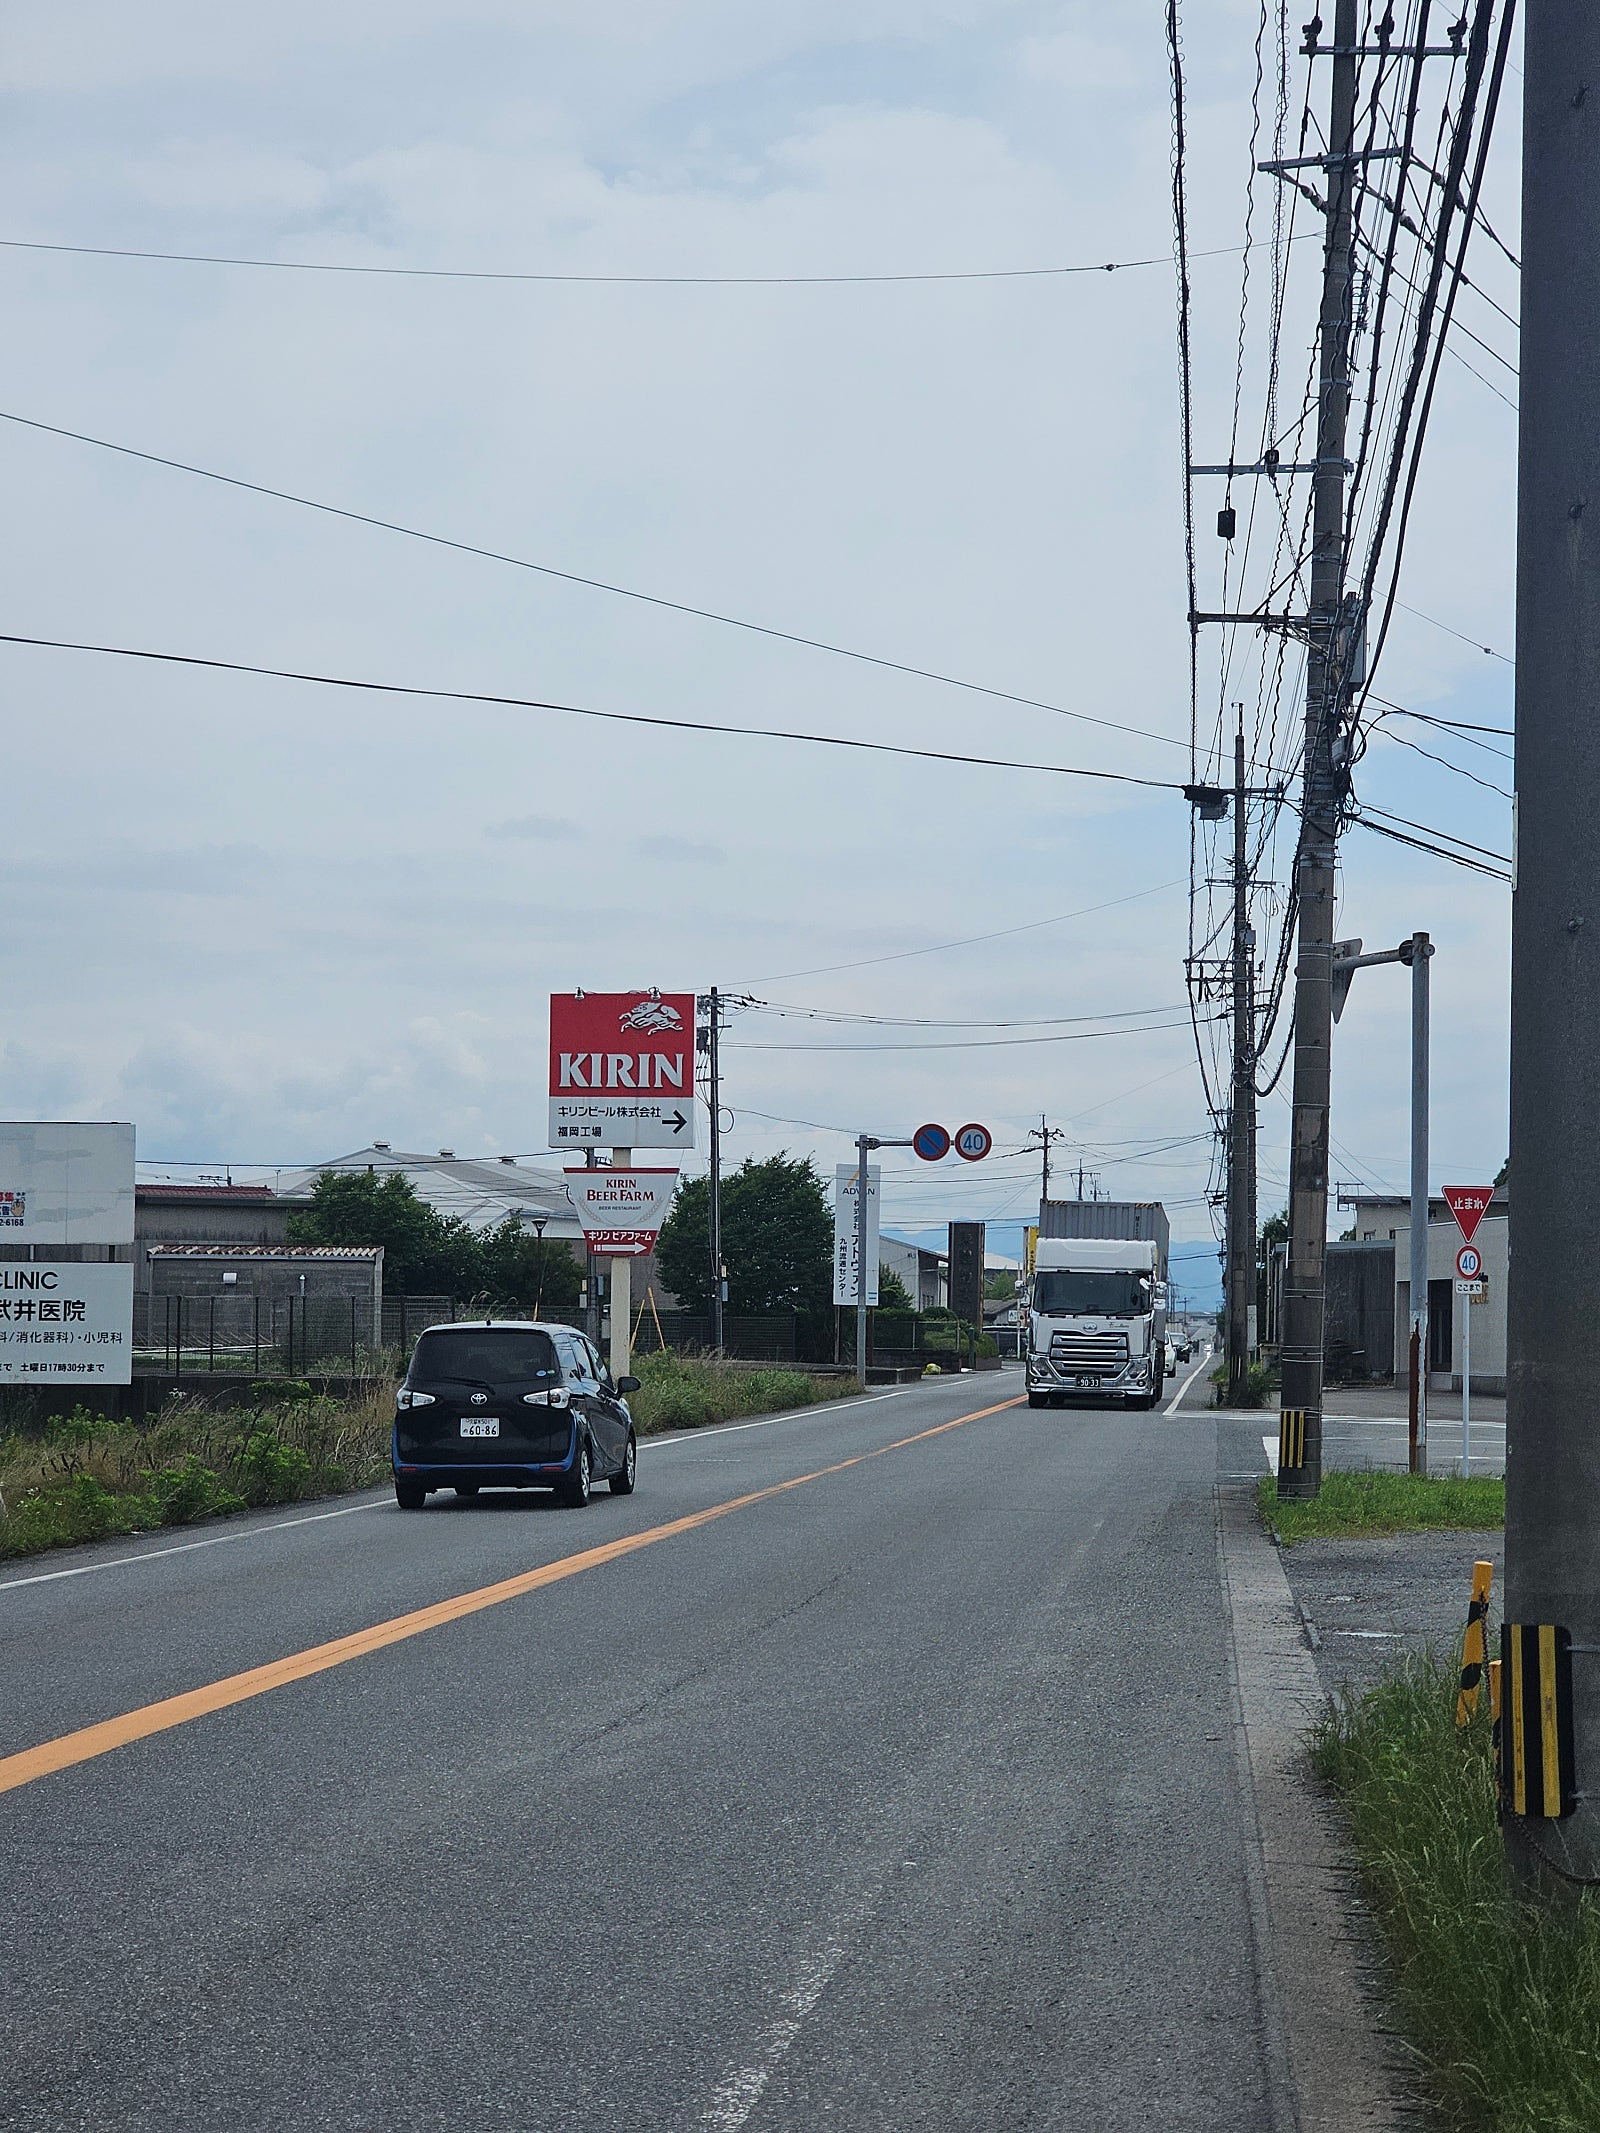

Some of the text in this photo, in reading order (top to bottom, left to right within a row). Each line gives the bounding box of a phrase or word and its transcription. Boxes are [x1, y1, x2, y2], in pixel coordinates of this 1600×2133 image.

[559, 1053, 684, 1088] KIRIN
[558, 1106, 661, 1118] キリンビール株式会社
[558, 1126, 602, 1137] 福岡工場
[963, 1134, 984, 1151] 40
[606, 1179, 636, 1188] KIRIN
[587, 1189, 654, 1201] BEER FARM
[842, 1187, 875, 1195] ADVN
[1453, 1197, 1484, 1210] 止まれ
[0, 1205, 10, 1216] 告
[588, 1231, 610, 1241] キリン
[839, 1237, 848, 1298] 九州流通センター
[1462, 1255, 1476, 1271] 40
[0, 1271, 58, 1290] LINIC
[1457, 1284, 1481, 1292] ここまで
[0, 1363, 105, 1373] で 土曜日17時30分まで
[1080, 1378, 1099, 1387] 90-33
[469, 1425, 497, 1435] 60-86
